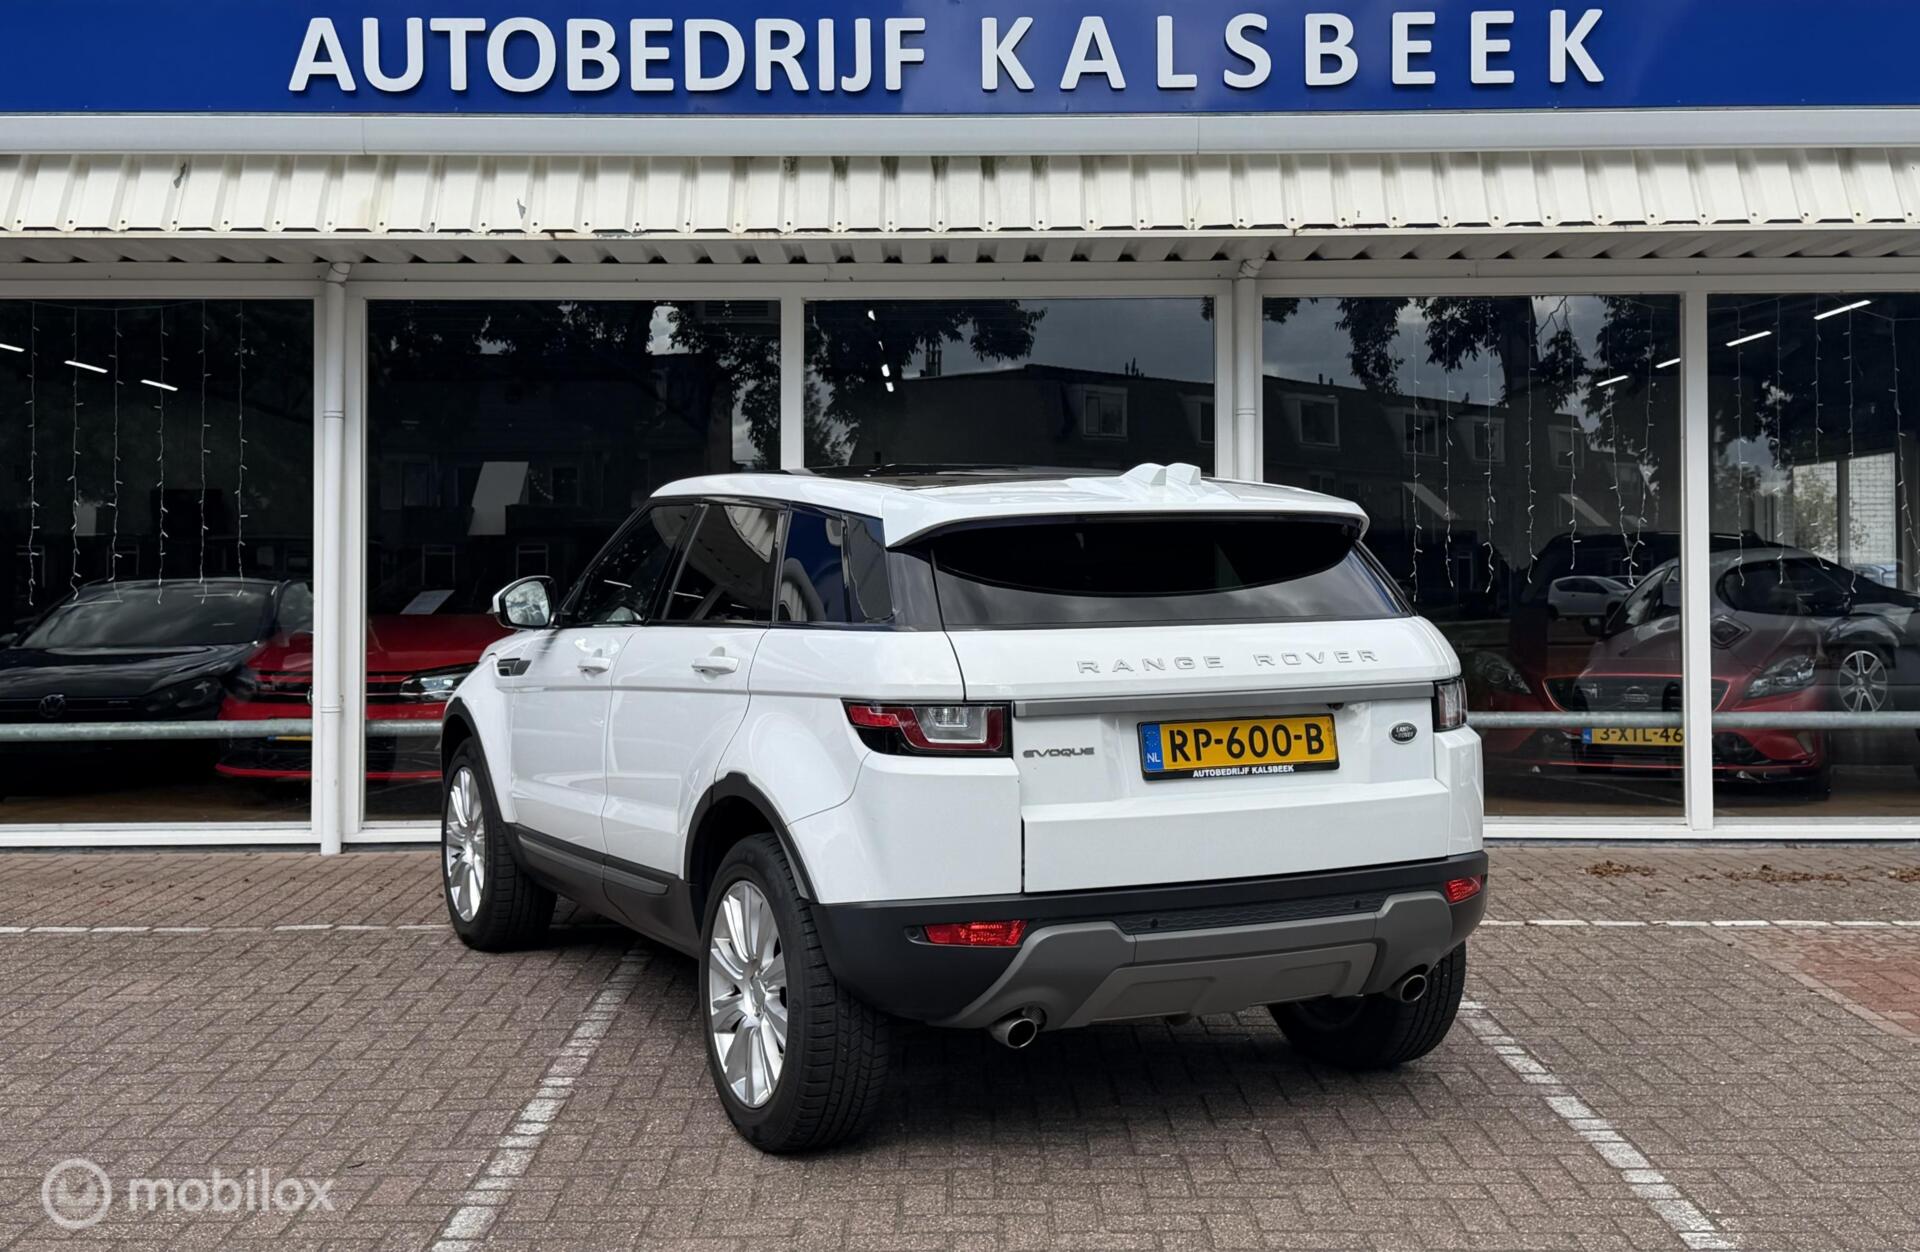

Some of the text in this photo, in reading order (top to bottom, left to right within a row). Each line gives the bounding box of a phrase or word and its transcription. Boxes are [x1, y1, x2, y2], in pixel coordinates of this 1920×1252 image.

[288, 8, 1605, 93] AUTOBEDRIJF KALSBEEK
[1077, 649, 1379, 674] RANGE ROVER
[1023, 747, 1095, 758] EVOQUE
[1169, 723, 1325, 763] RP-600-B
[1147, 752, 1161, 763] NL
[1193, 764, 1294, 778] AUTOBEDRIJF KALSBEEK
